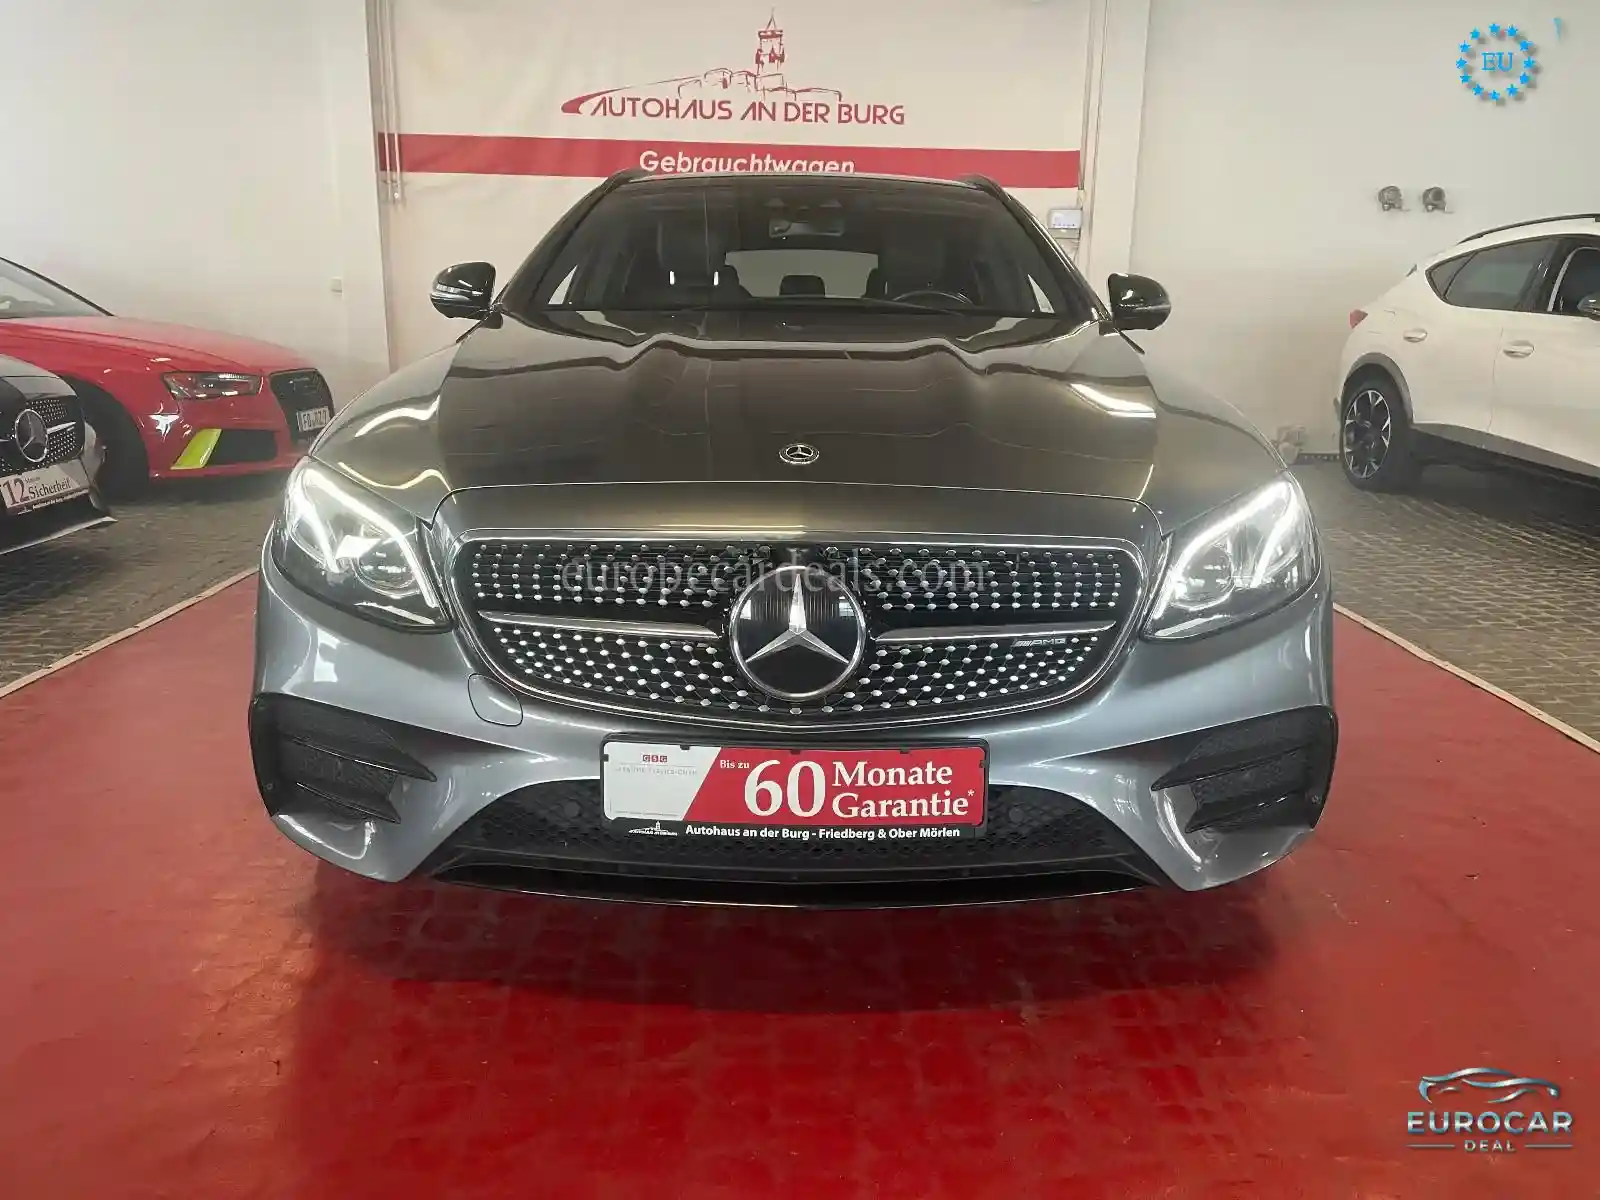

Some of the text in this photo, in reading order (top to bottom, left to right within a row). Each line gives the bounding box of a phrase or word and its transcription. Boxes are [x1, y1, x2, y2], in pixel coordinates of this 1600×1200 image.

[590, 96, 905, 126] AUTOHAUS AN DER BURG
[639, 150, 855, 173] Gebrauchtwagen
[3, 478, 29, 505] 12
[28, 477, 72, 499] Sicherheit
[720, 759, 750, 769] Bis zu
[832, 761, 953, 787] Monate
[744, 760, 826, 818] 60
[685, 824, 740, 837] Autohaus
[743, 828, 757, 838] an
[759, 827, 779, 838] der
[782, 828, 810, 840] Burg
[819, 828, 874, 841] Friedberg
[878, 828, 886, 839] &
[889, 828, 918, 839] Ober
